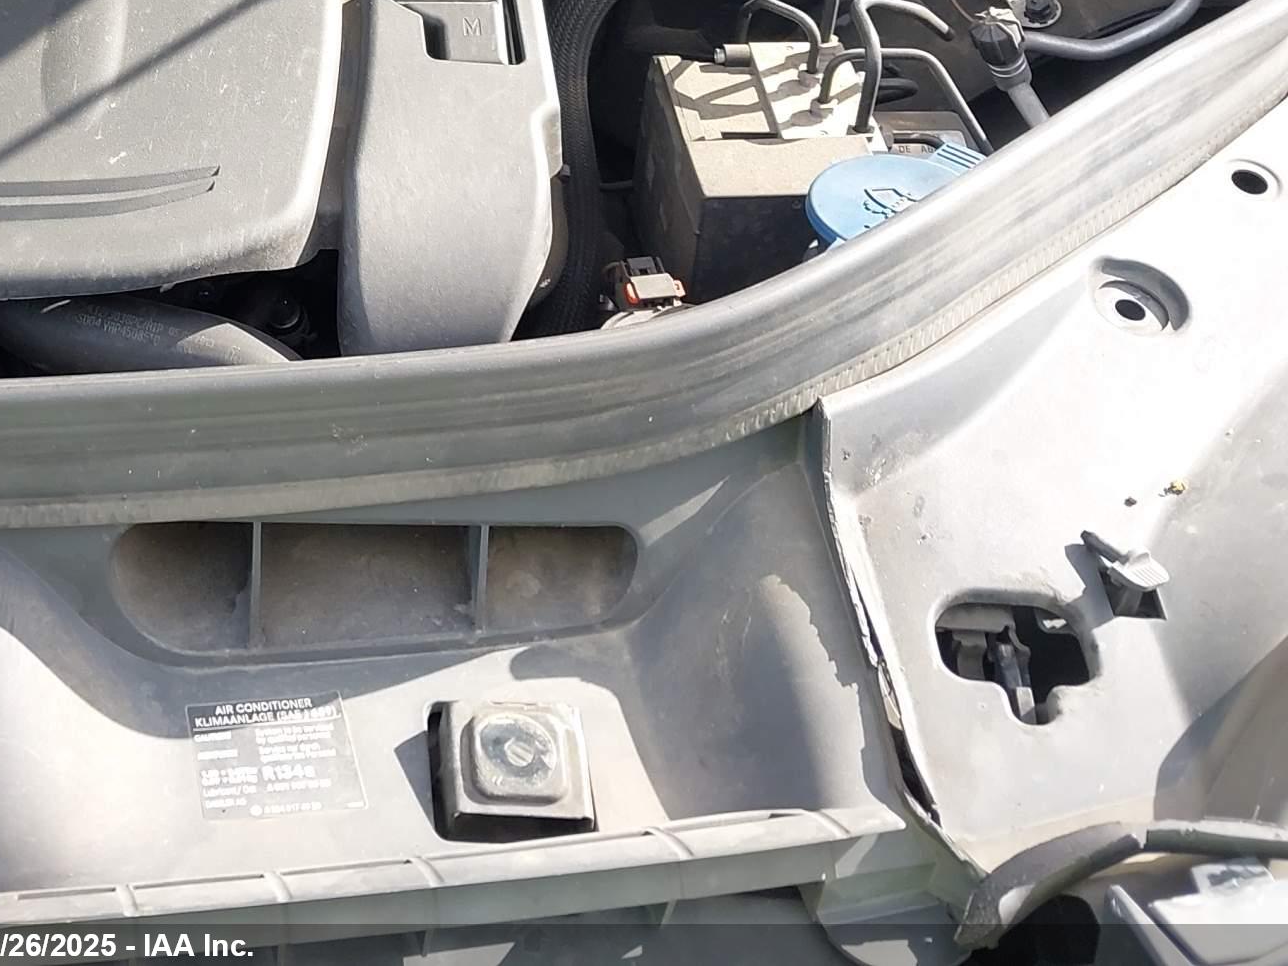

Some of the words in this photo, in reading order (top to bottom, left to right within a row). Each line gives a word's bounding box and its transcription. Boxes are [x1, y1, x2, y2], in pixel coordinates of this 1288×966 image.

[215, 704, 234, 716] AIR
[235, 697, 313, 714] CONDITIONER
[194, 711, 274, 728] KLIMAANLAGE
